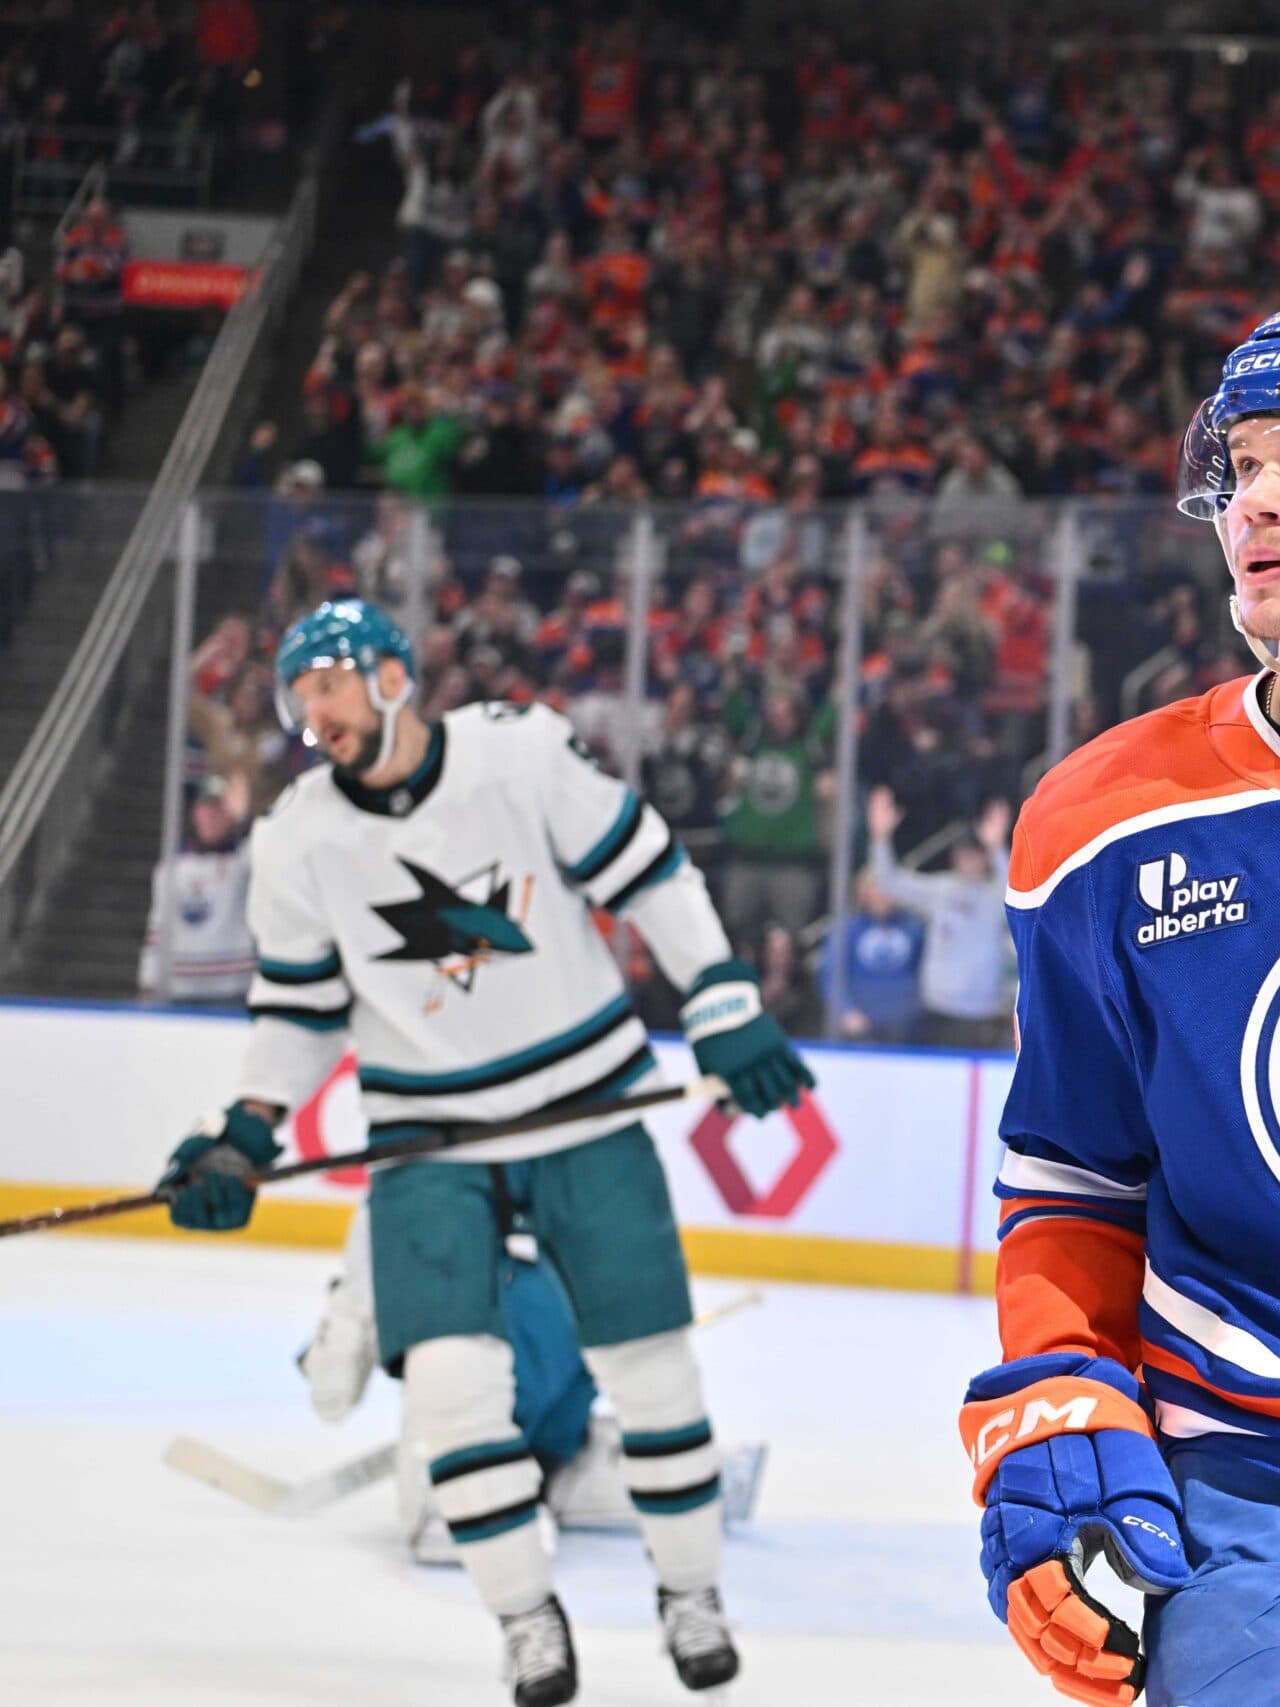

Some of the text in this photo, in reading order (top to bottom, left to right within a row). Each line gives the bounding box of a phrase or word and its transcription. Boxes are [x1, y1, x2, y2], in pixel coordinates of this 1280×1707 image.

[1172, 877, 1239, 914] play
[1137, 902, 1245, 945] alberta
[971, 1396, 1099, 1466] CM
[1121, 1514, 1178, 1548] CCM
